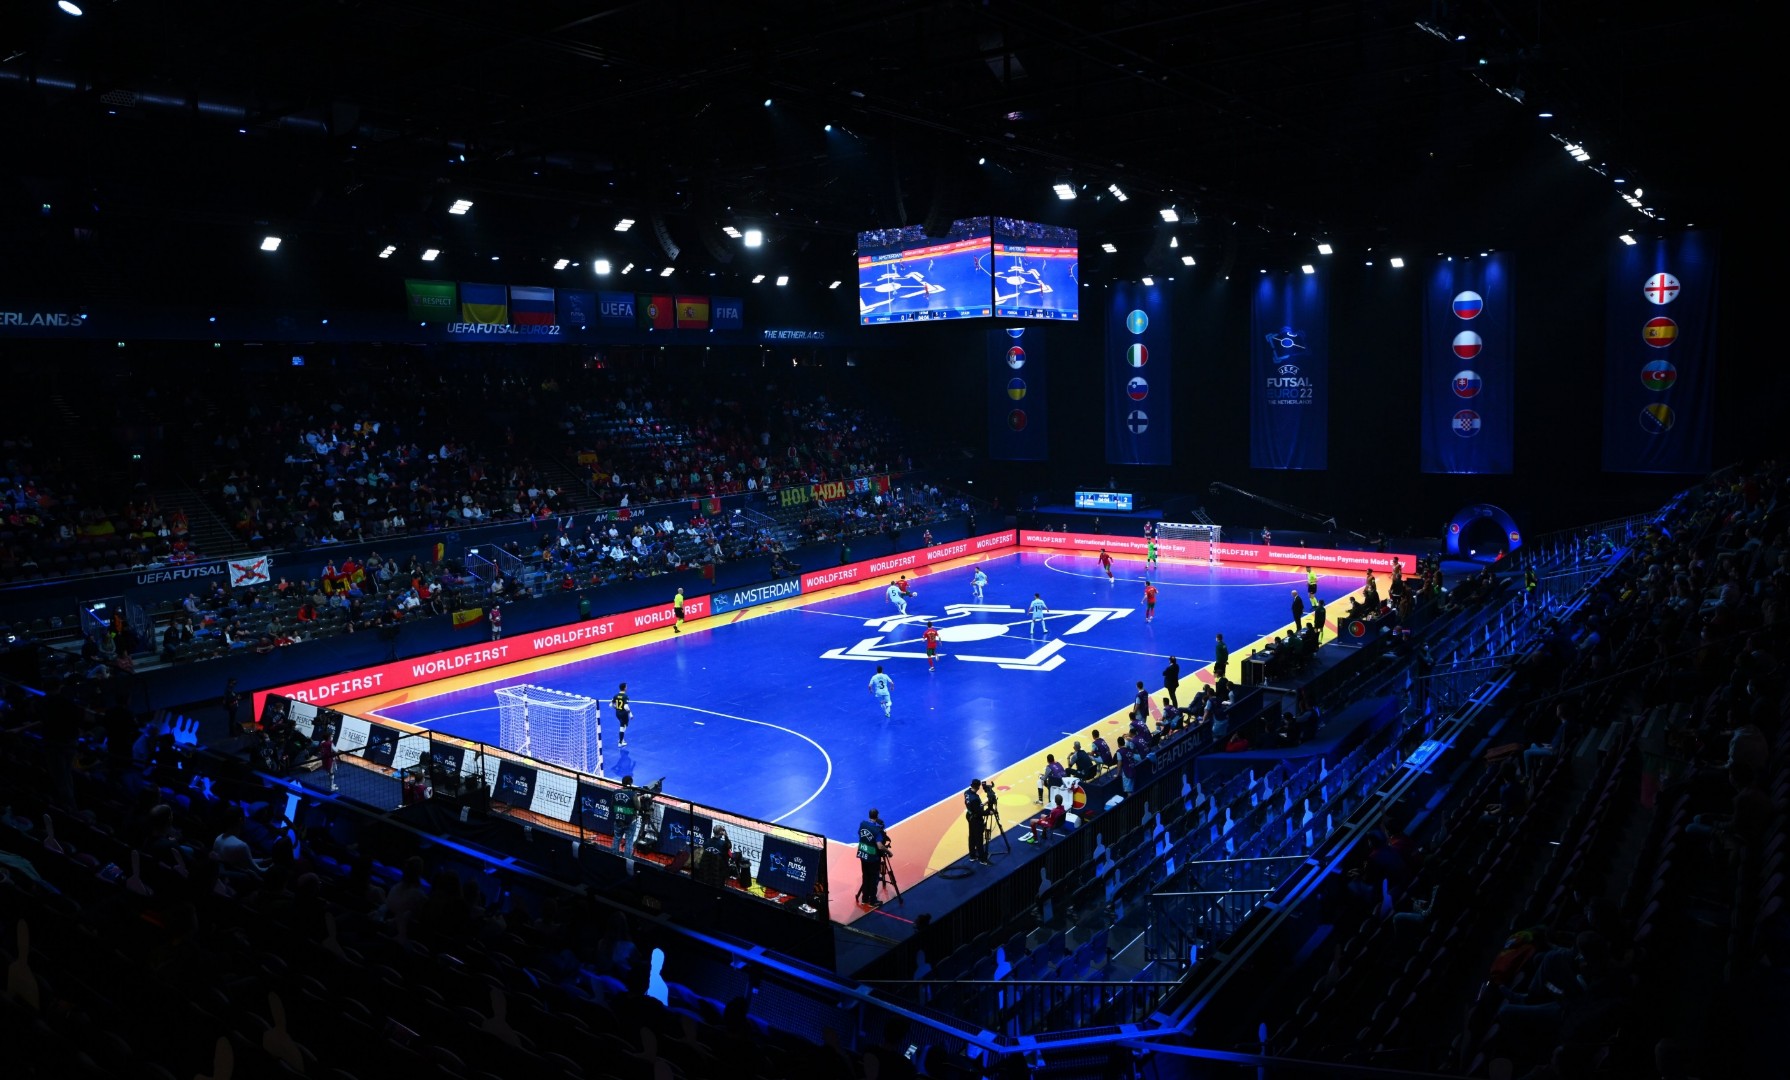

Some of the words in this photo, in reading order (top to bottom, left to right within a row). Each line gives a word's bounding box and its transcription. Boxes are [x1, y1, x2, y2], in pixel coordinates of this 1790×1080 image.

[600, 303, 634, 316] UEFA
[716, 307, 738, 319] FIFA
[1266, 377, 1313, 388] FUTSAL
[976, 533, 1013, 549] WORLDFIRST
[1026, 536, 1067, 544] WORLDFIRST
[1074, 538, 1106, 546] International
[927, 543, 968, 560] WORLDFIRST
[1212, 548, 1259, 557] WORLDFIRST
[1268, 551, 1307, 560] International
[1308, 554, 1336, 562] Business
[1337, 556, 1369, 564] Payments
[1370, 558, 1389, 566] Made
[870, 555, 916, 573] WORLDFIRST
[806, 568, 857, 587] WORLDFIRST
[733, 579, 800, 606] AMSTERDAM
[634, 602, 704, 627] WORLDFRST
[533, 622, 615, 650] WORLDFIRST
[412, 645, 509, 678] WORLDFIRST
[878, 680, 885, 690] 3
[615, 699, 623, 710] 12
[545, 790, 572, 805] RESPECT
[732, 843, 762, 860] ESPECT
[787, 861, 807, 873] FUTSAL
